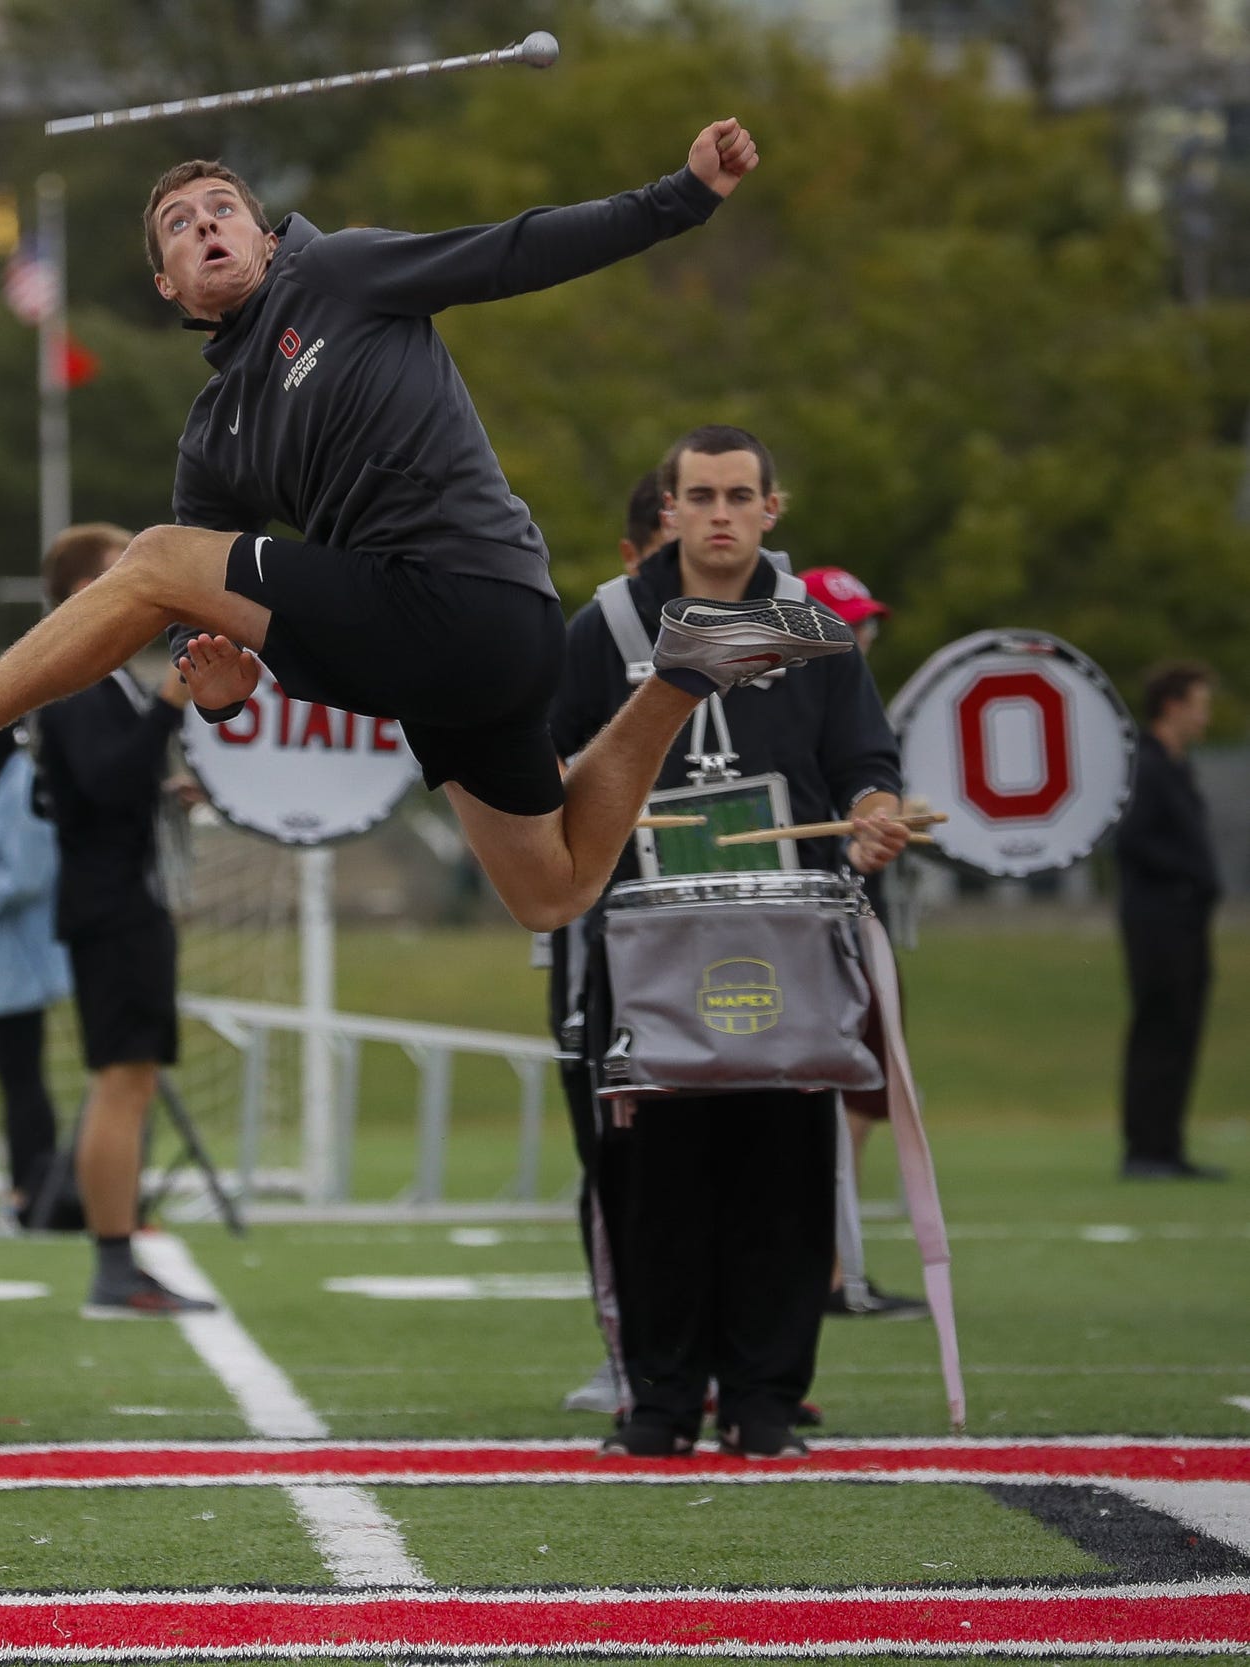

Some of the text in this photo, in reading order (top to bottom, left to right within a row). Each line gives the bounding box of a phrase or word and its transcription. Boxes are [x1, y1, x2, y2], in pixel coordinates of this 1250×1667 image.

[279, 327, 301, 359] O
[283, 338, 325, 391] MARCHING
[293, 357, 317, 387] BAND
[953, 667, 1074, 826] O
[707, 993, 773, 1008] MAPEX
